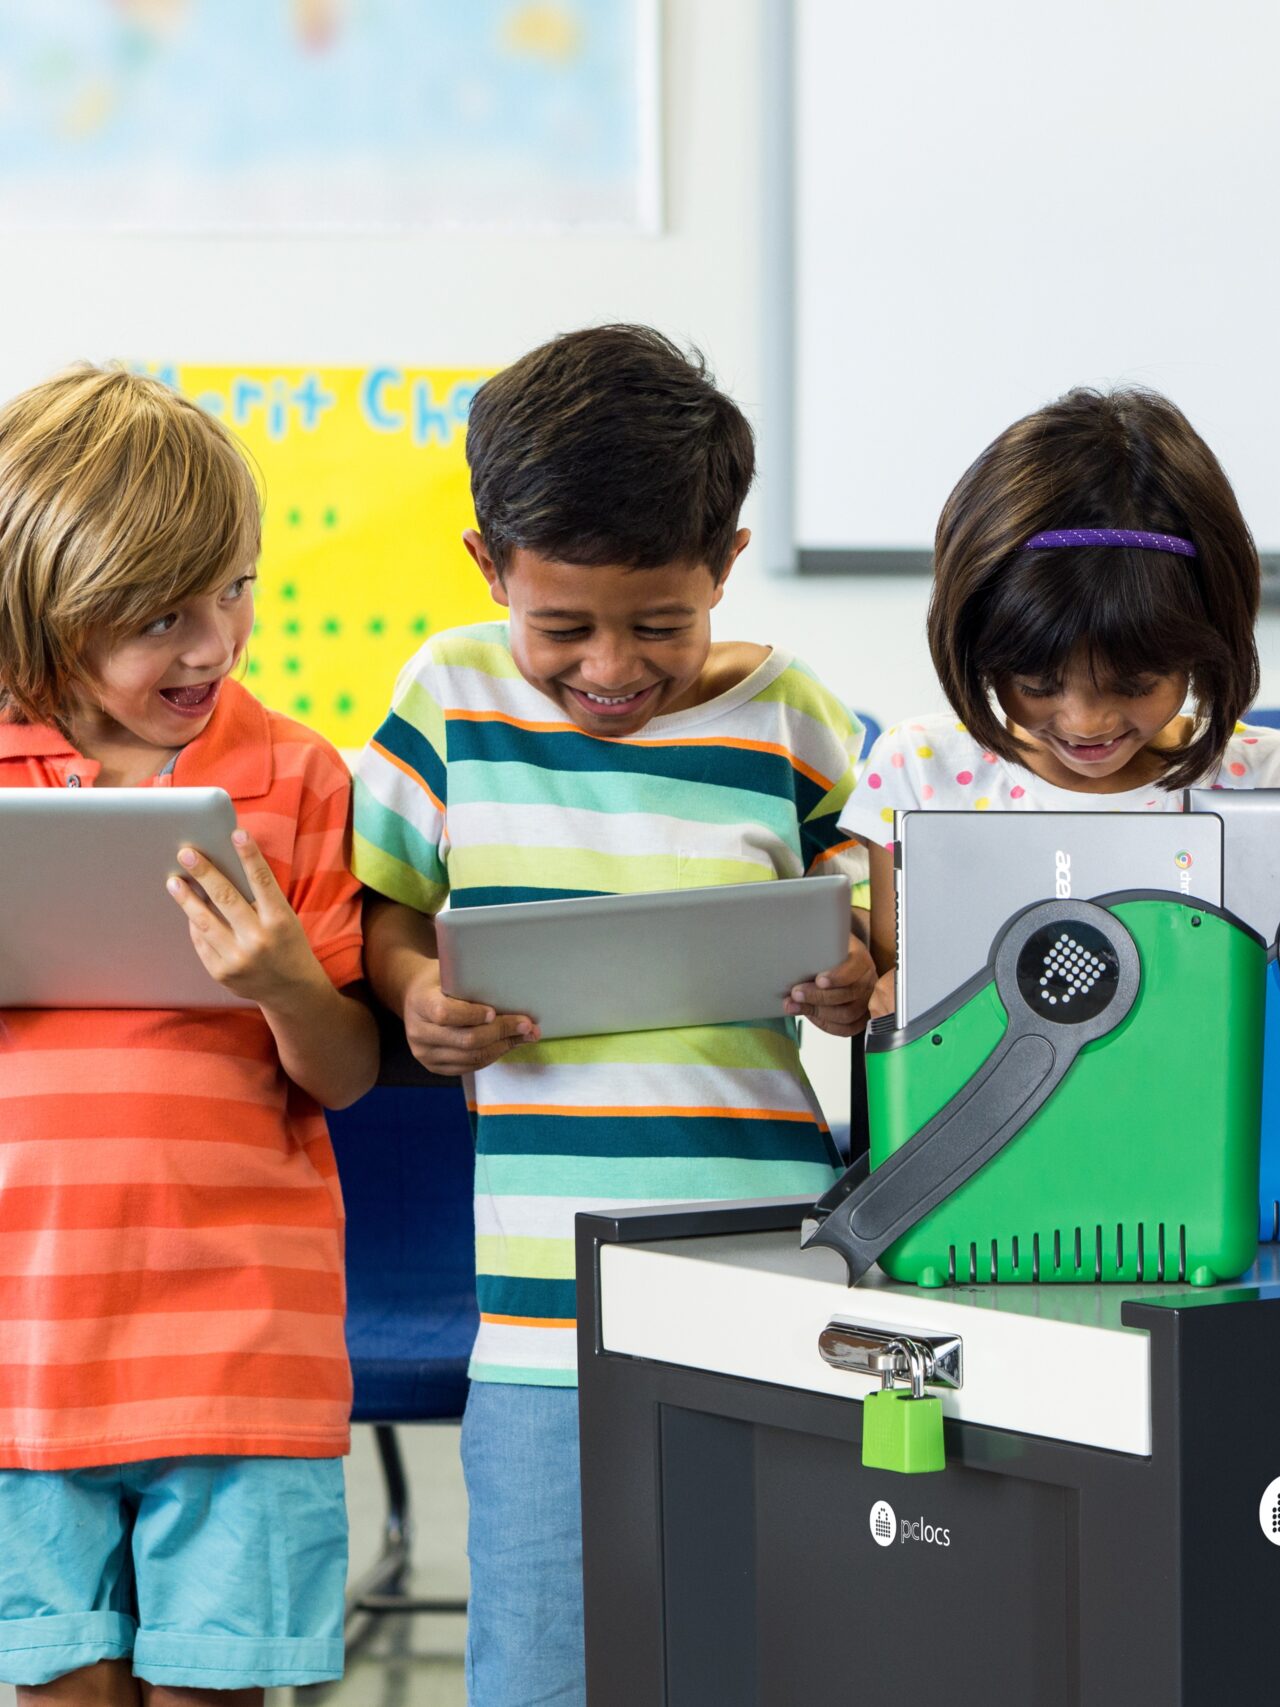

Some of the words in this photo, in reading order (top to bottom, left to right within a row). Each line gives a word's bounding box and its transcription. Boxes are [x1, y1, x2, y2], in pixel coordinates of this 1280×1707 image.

[130, 361, 333, 438] rit
[1055, 850, 1071, 899] ace
[901, 1516, 950, 1546] pclocs
